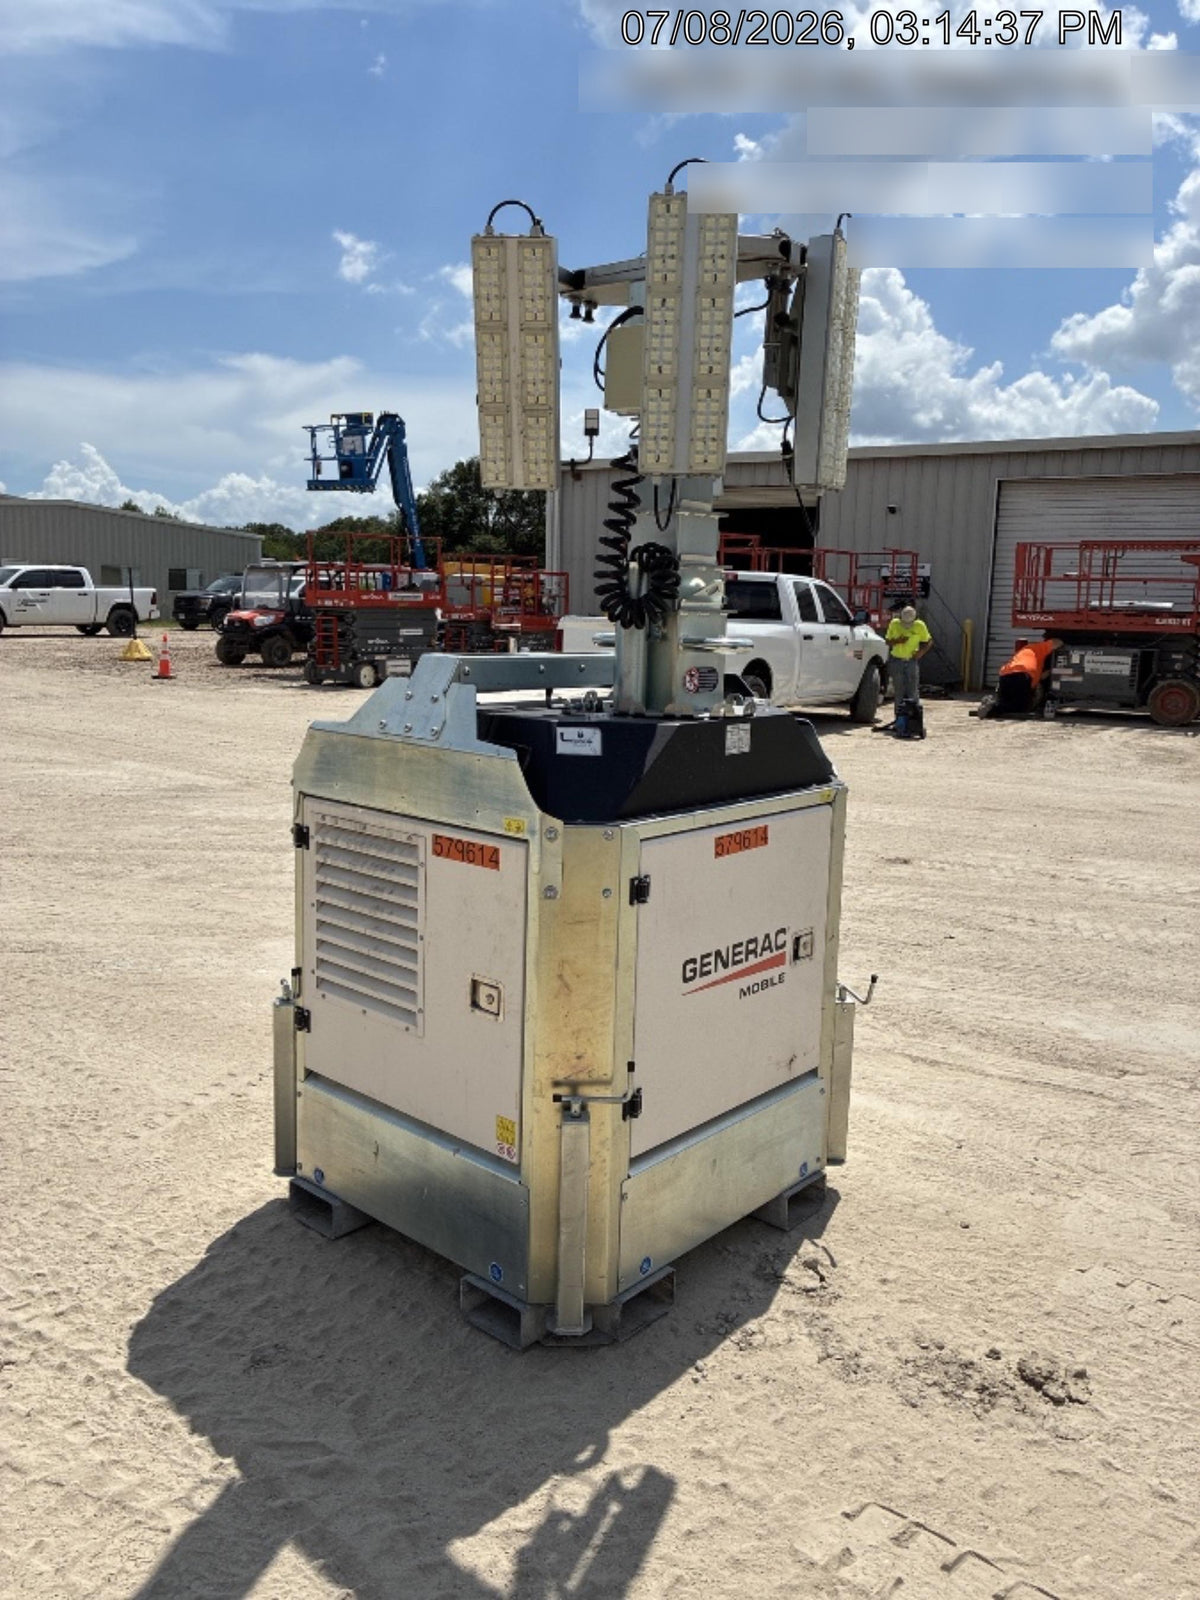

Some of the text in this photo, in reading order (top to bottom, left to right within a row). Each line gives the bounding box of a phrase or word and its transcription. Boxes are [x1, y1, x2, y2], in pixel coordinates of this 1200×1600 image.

[433, 835, 499, 867] 579614
[715, 826, 768, 857] 579614
[682, 927, 787, 983] GENERAC
[739, 972, 787, 999] MOBILE
